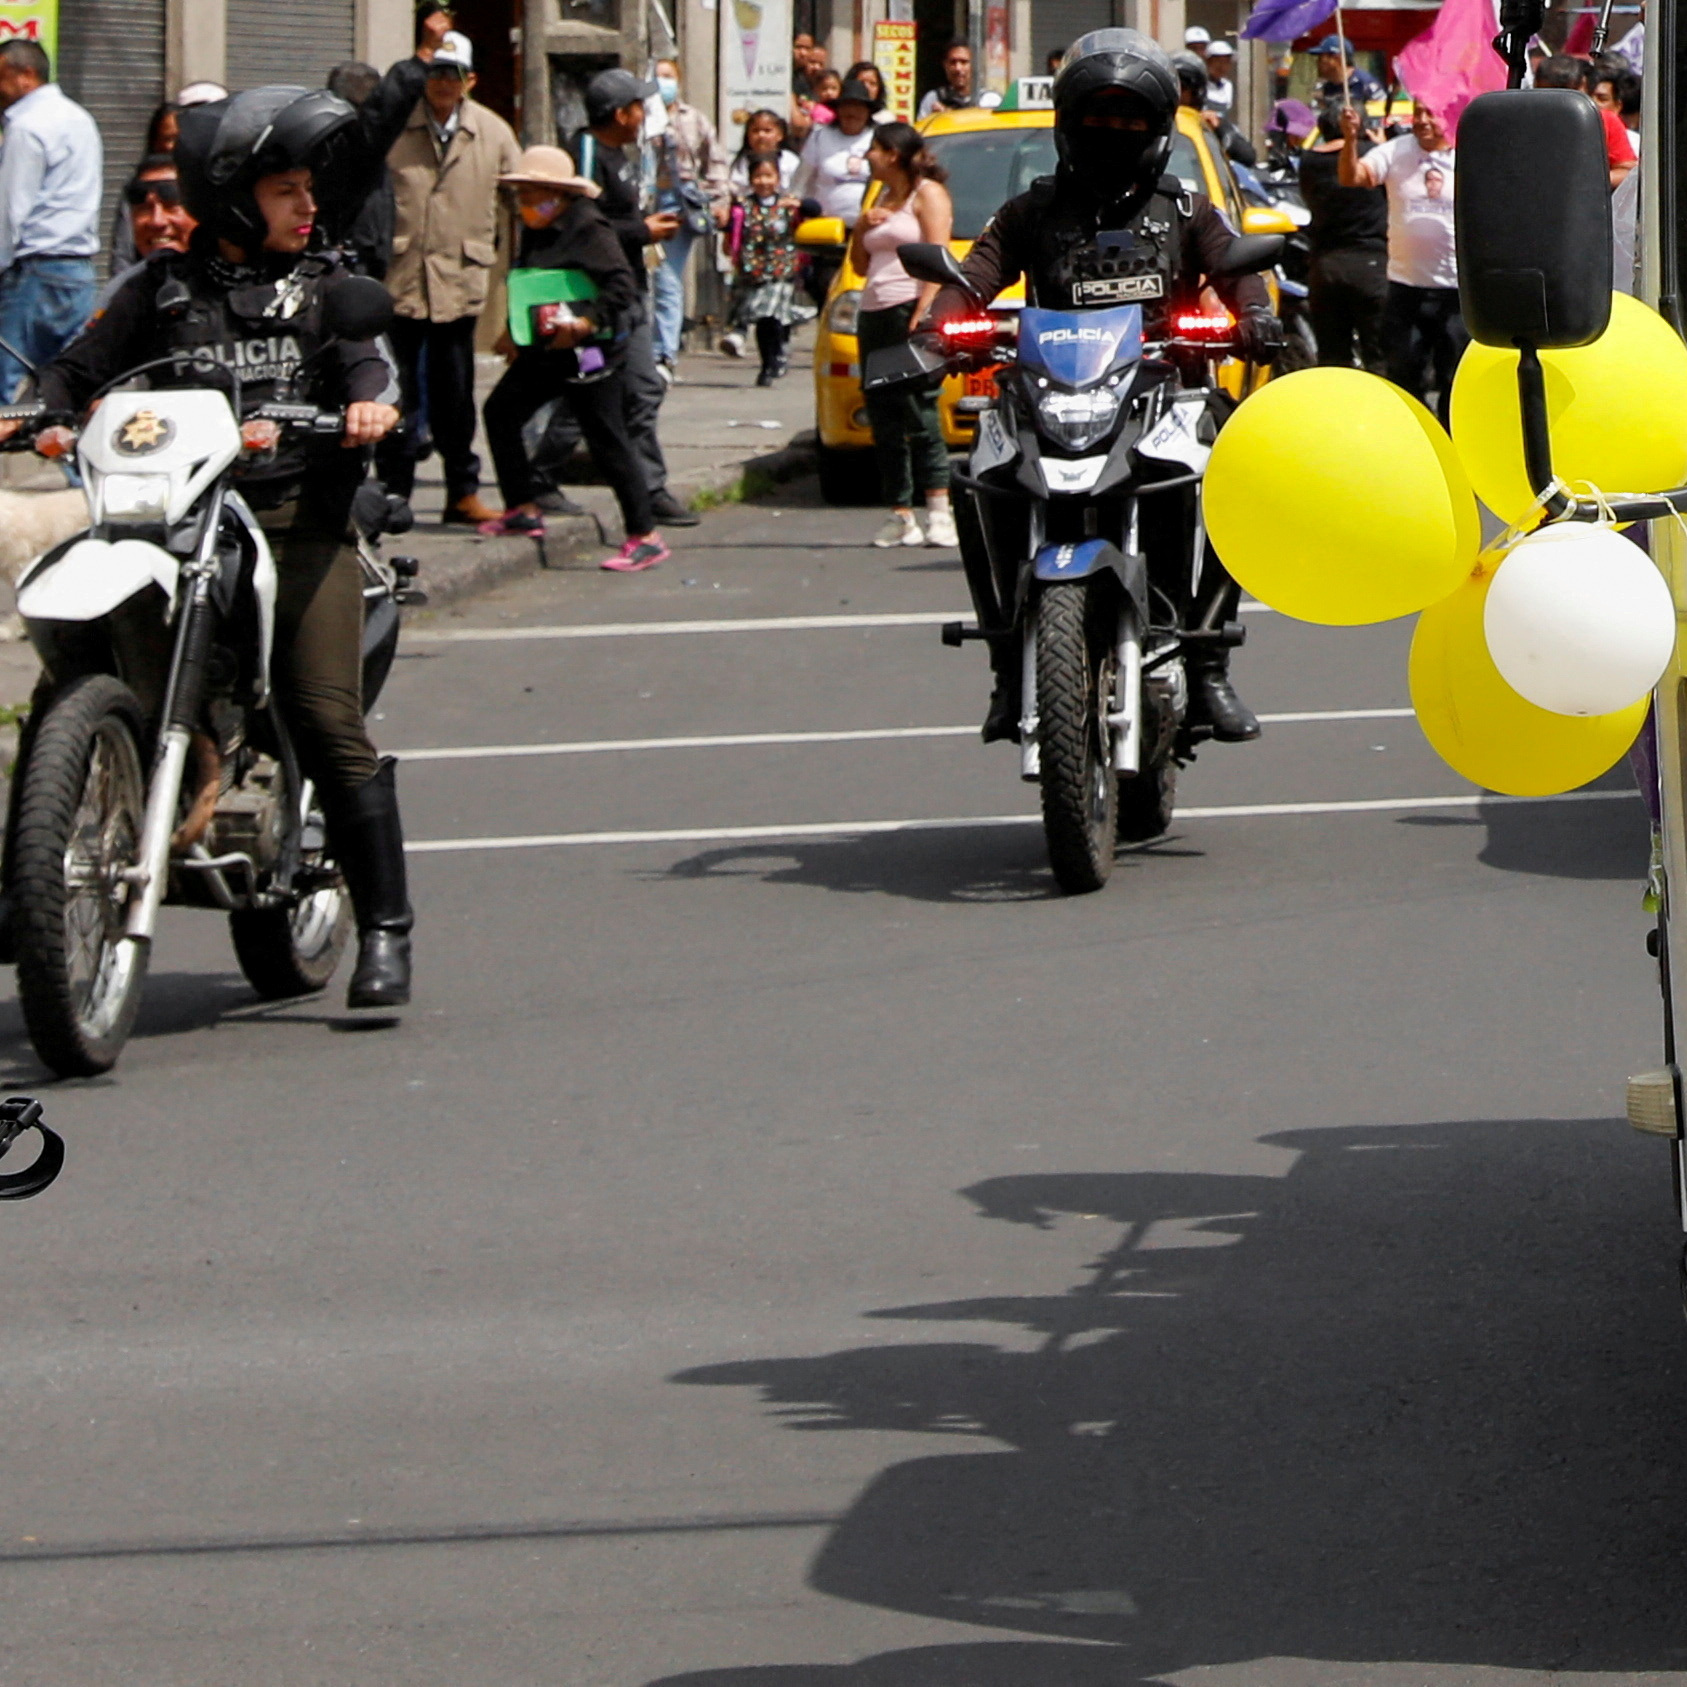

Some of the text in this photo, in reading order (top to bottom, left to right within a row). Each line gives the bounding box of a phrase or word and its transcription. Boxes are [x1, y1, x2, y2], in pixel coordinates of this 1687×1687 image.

[896, 42, 911, 123] ALMUER
[1022, 81, 1053, 102] TA
[1078, 279, 1158, 297] POLICIA
[171, 335, 302, 377] POLICIA
